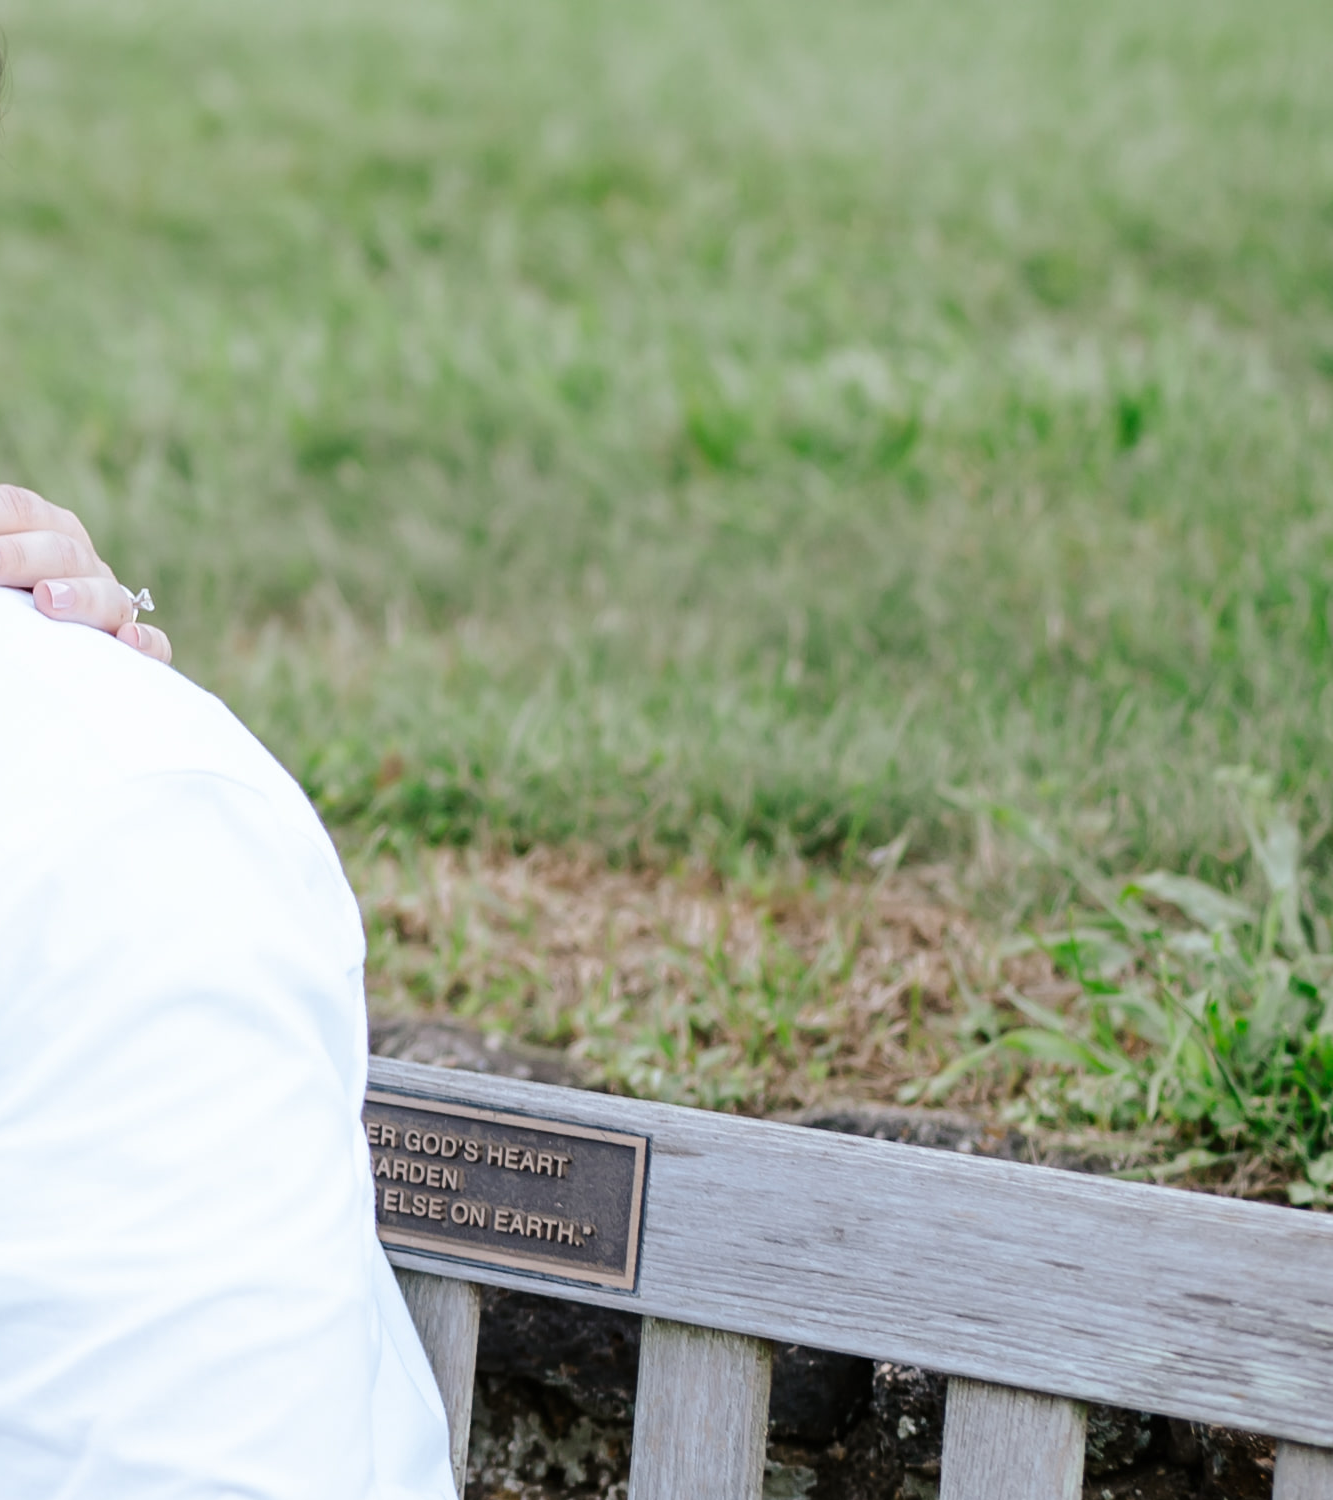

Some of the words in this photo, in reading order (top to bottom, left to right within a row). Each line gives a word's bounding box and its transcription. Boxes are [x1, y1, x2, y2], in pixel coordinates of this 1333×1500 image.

[371, 1155, 458, 1191] ARDEN
[404, 1129, 479, 1162] GOD'S
[487, 1145, 570, 1178] HEART
[383, 1189, 444, 1220] ELSE
[451, 1202, 486, 1228] ON
